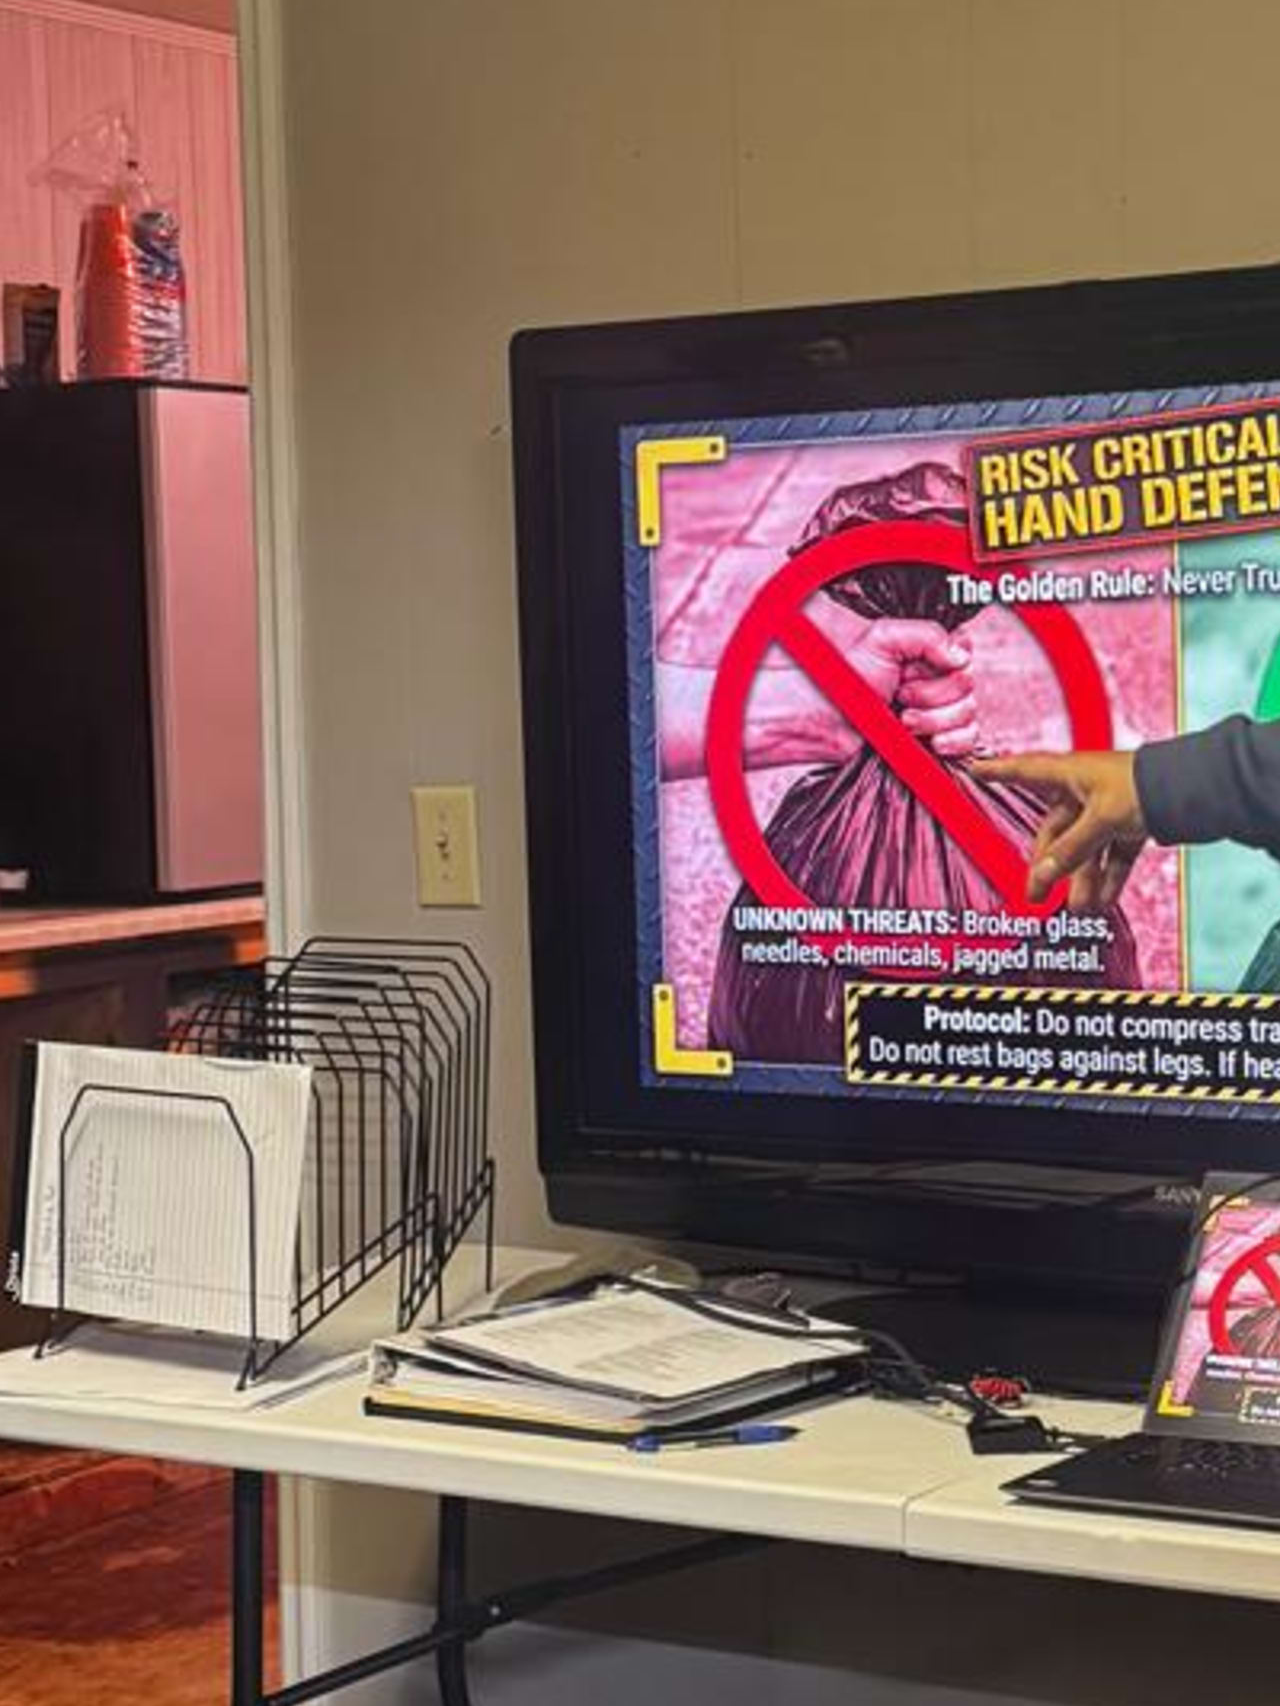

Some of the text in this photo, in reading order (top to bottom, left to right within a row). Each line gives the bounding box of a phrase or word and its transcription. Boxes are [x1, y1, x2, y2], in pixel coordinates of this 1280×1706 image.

[981, 442, 1078, 494] RISK
[984, 491, 1123, 548] HAND
[946, 574, 992, 603] The
[998, 571, 1083, 602] Golden
[1090, 568, 1155, 597] Rule:
[1163, 566, 1233, 595] Never
[733, 907, 1114, 944] UNKNOWN THREATS: Broken glass,
[741, 937, 1105, 974] needles, chemicals, jagged metal.
[923, 1004, 1031, 1034] Protocol:
[1036, 1008, 1069, 1036] Do
[1075, 1011, 1115, 1038] not
[1120, 1017, 1243, 1045] compress
[869, 1037, 900, 1062] Do
[905, 1040, 942, 1065] not
[947, 1042, 991, 1068] rest
[997, 1041, 1053, 1074] bags
[1059, 1044, 1146, 1075] against
[1153, 1047, 1212, 1081] legs.
[1220, 1050, 1236, 1079] If
